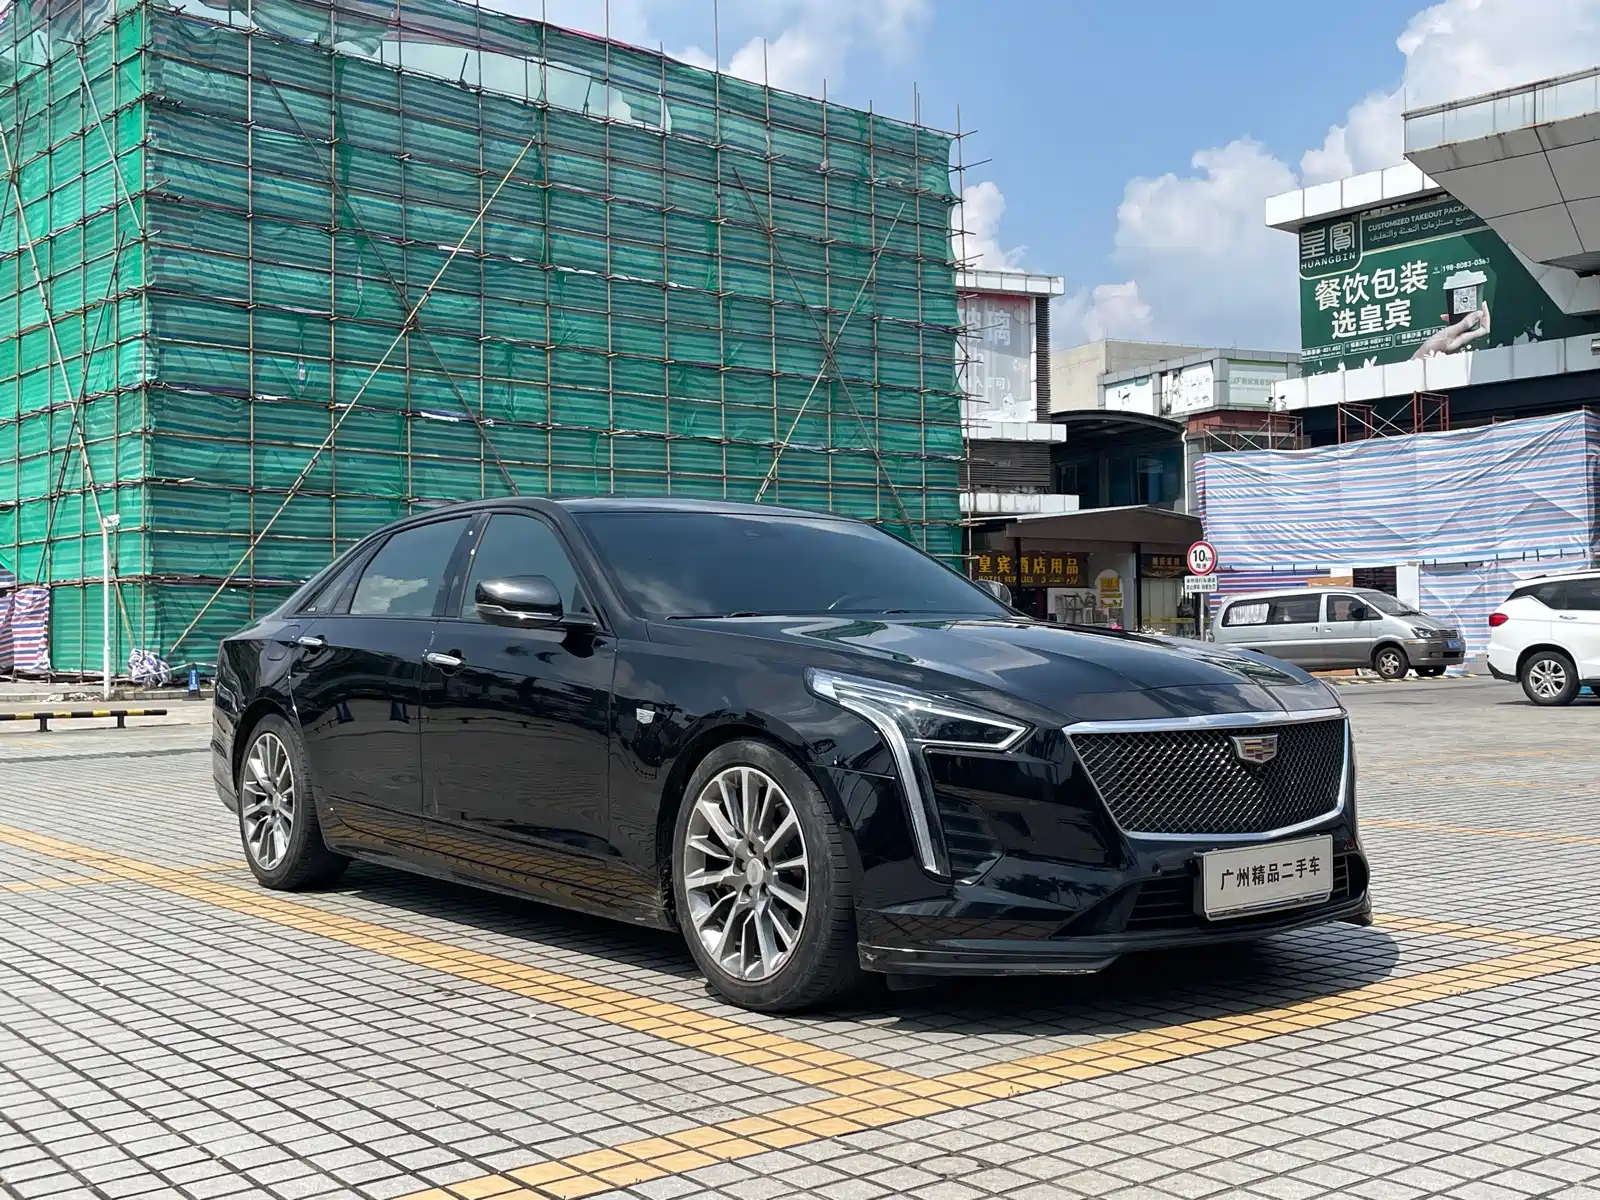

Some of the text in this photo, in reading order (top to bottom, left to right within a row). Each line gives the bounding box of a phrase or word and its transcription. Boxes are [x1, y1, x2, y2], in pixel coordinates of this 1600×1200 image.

[1368, 216, 1410, 232] CUSTOMIZED
[1411, 209, 1443, 222] TAKEOUT
[1301, 252, 1356, 270] HUANGBIN
[1442, 257, 1491, 273] 198-8083-0363
[1314, 259, 1429, 312] 餐饮包装
[1331, 299, 1412, 340] 选皇宾
[1220, 856, 1321, 891] 广州精品二手车
